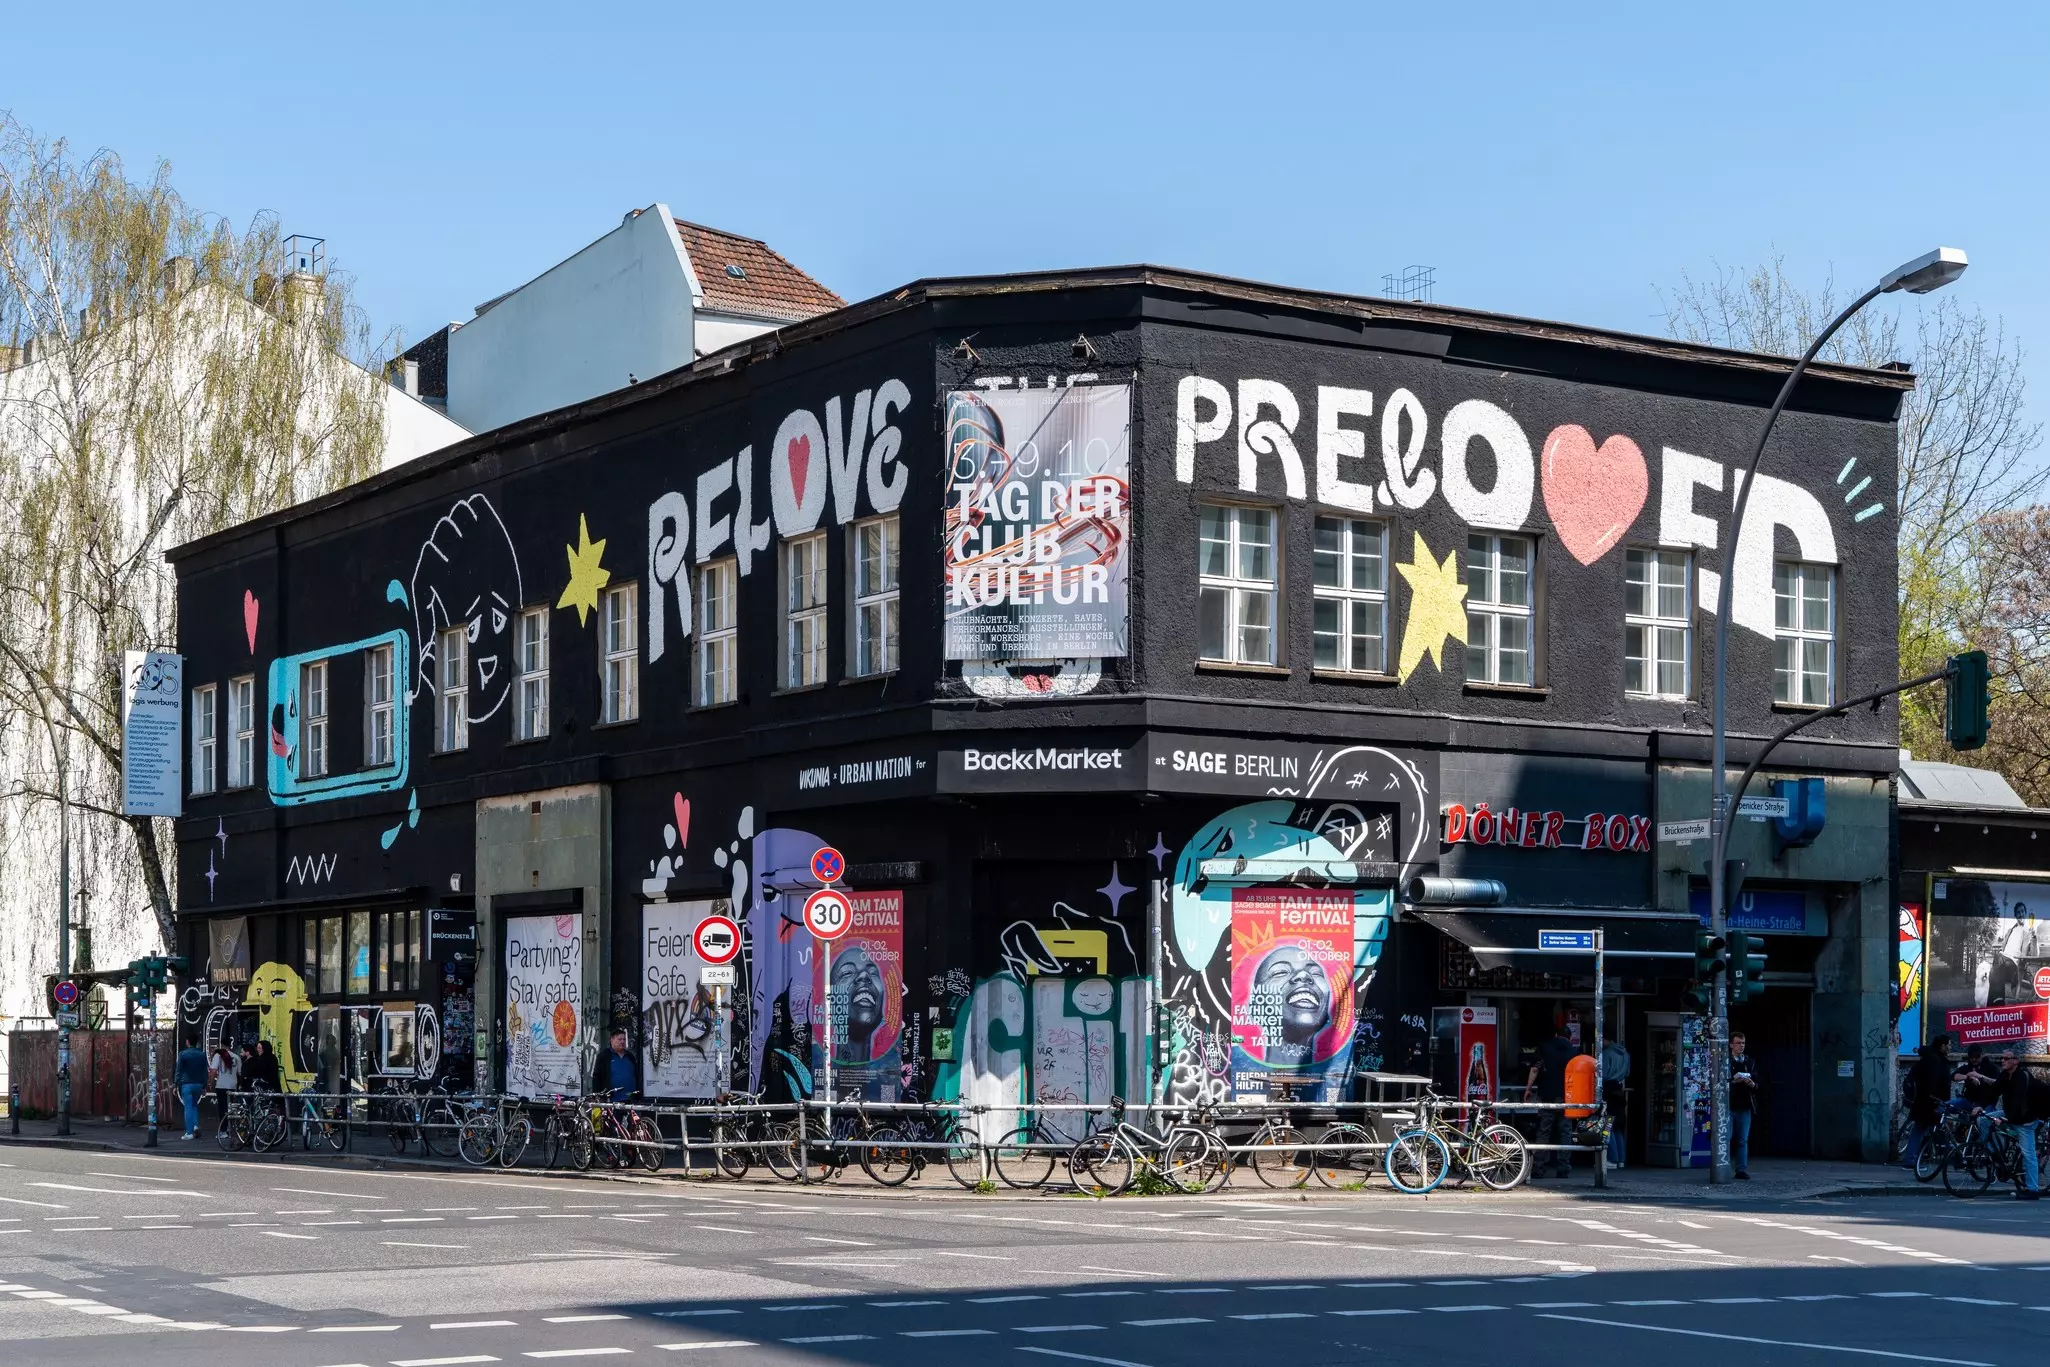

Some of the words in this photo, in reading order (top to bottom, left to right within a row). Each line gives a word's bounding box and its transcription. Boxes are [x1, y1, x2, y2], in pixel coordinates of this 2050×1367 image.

[953, 481, 1029, 522] TAG
[1041, 479, 1121, 520] DER
[648, 378, 911, 665] RELOVE
[953, 524, 1062, 565] CLUB
[952, 564, 1109, 607] KULTUR
[952, 614, 1012, 625] CLUBNÄCHTE,
[1019, 614, 1068, 624] KONZERTE,
[1074, 613, 1107, 623] RAVES,
[952, 624, 1023, 634] PERFORMANCES,
[1030, 623, 1107, 633] AUSSTELLUNGEN,
[952, 633, 984, 643] TALKS,
[991, 633, 1041, 642] WORKSHOPS
[1058, 632, 1081, 641] EINE
[1086, 631, 1114, 641] WOCHE
[952, 642, 975, 651] LANG
[980, 642, 996, 651] UND
[1002, 641, 1040, 651] ÜBERALL
[1048, 642, 1058, 650] IN
[1063, 641, 1097, 650] BERLIN
[147, 698, 179, 709] werbung
[840, 761, 873, 785] URBAN
[875, 756, 912, 781] NATION
[916, 760, 927, 769] for
[1155, 756, 1166, 766] at
[1172, 750, 1227, 774] SAGE
[1235, 754, 1299, 779] BERLIN
[1764, 801, 1785, 814] Straße
[1445, 801, 1565, 849] DÖNER
[1582, 811, 1652, 852] BOX
[1664, 823, 1705, 836] Brückenstraße
[874, 898, 899, 912] TAM
[1279, 896, 1312, 910] TAM
[1315, 896, 1349, 911] TAM
[1742, 892, 1754, 912] U
[814, 903, 842, 925] 30
[432, 931, 471, 940] BRÜCKENSTR.
[468, 925, 475, 940] 1
[509, 937, 581, 975] Partying?
[708, 970, 726, 978] 22-6
[647, 965, 690, 998] Safe.
[510, 975, 543, 1010] Stay
[545, 974, 581, 1003] safe.
[830, 995, 849, 1003] OOD
[1250, 995, 1283, 1005] FOOD
[1234, 1005, 1283, 1016] FASHION
[1950, 1012, 1982, 1027] Dieser
[1983, 1010, 2024, 1025] Moment
[833, 1025, 849, 1035] ART
[1261, 1026, 1283, 1036] ART
[1965, 1025, 2004, 1039] verdient
[2006, 1023, 2021, 1036] ein
[2022, 1021, 2046, 1037] Jubi.
[831, 1035, 849, 1045] ALKS
[1250, 1036, 1284, 1047] TALKS
[1235, 1081, 1264, 1090] HILFT!
